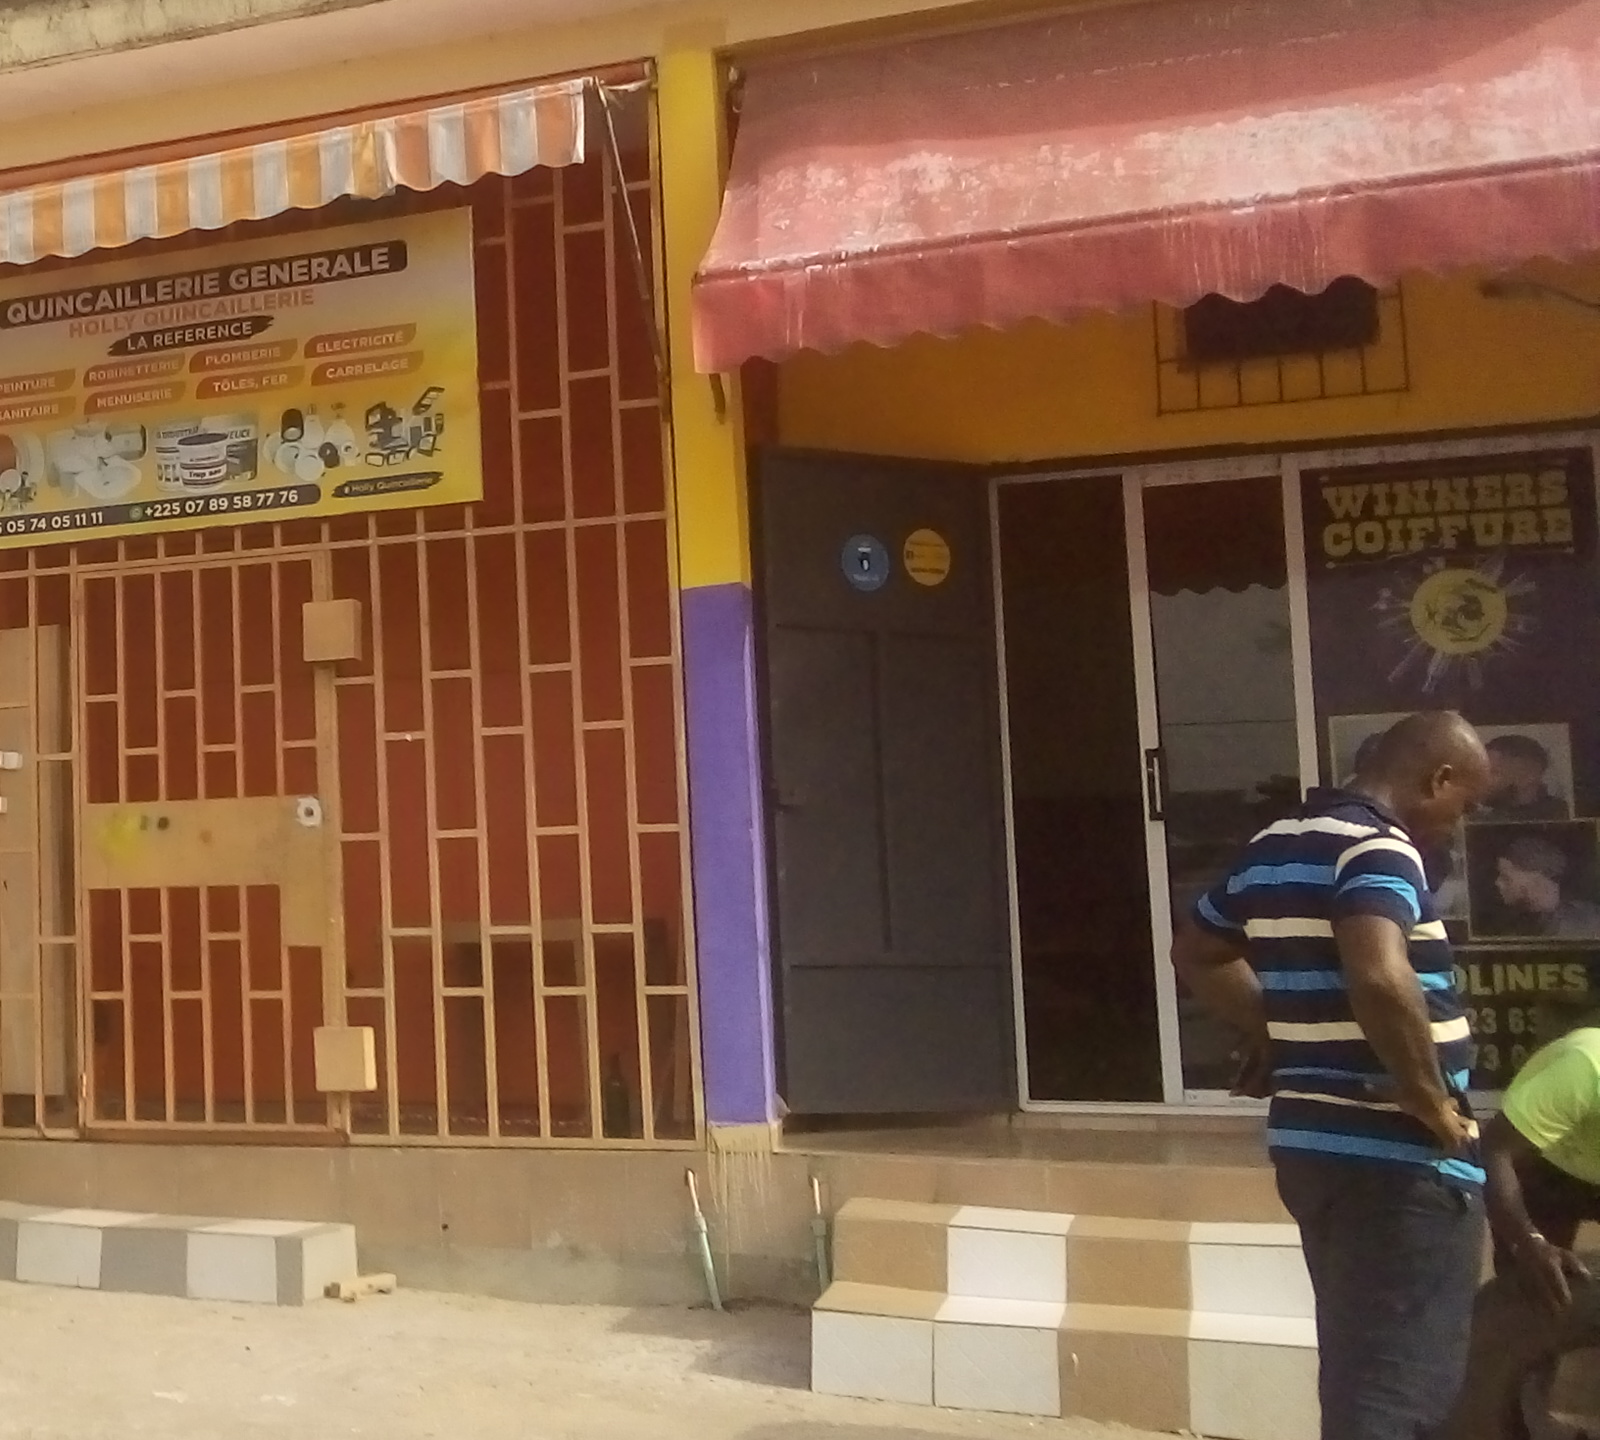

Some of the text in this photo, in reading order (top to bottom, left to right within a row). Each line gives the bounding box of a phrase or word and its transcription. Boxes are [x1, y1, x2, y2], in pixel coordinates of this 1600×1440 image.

[7, 247, 390, 324] QUINCAILLERIE GENERALE
[69, 289, 314, 338] HOLLY QUINCAILLERIE
[127, 321, 252, 351] LA REFERENCE
[205, 347, 280, 365] PLOMBERIE
[88, 360, 179, 381] ROBINETTERIE
[326, 358, 409, 379] CARRELAGE
[212, 373, 288, 392] TÔLES, FER
[96, 389, 172, 408] MENUISERIE
[144, 490, 298, 518] +225 07 89 58 77 76
[1322, 470, 1569, 519] WINNERS
[6, 519, 25, 532] 05
[30, 517, 47, 530] 74
[51, 515, 71, 528] 05
[74, 513, 87, 526] 11
[90, 511, 103, 525] 11
[1323, 508, 1574, 557] COIFFURE
